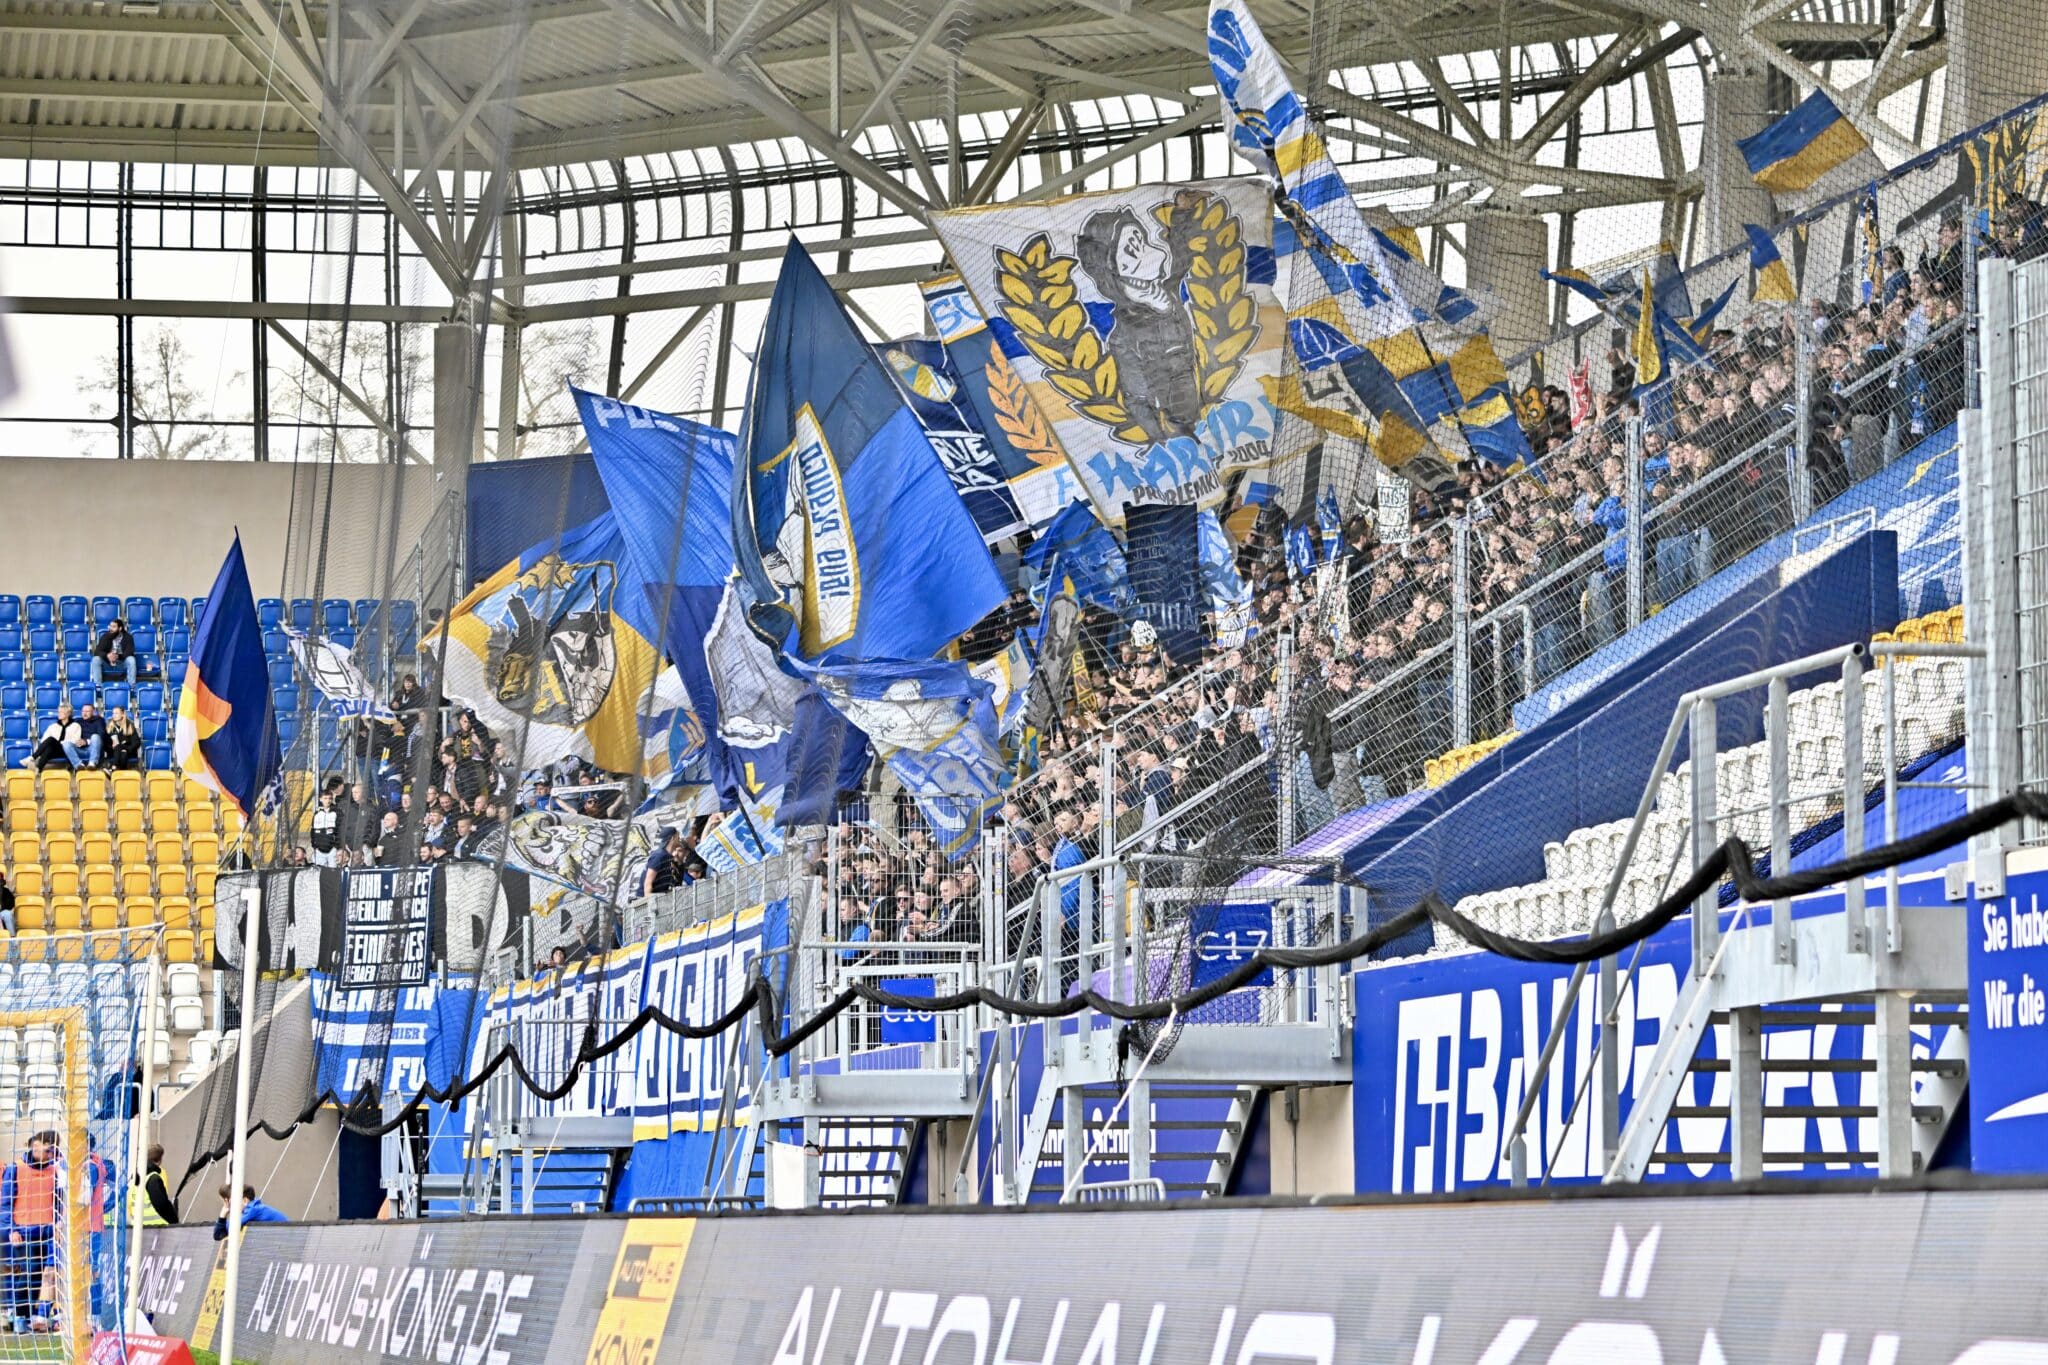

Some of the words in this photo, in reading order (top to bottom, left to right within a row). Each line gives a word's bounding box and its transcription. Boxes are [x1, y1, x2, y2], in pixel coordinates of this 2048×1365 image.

[1195, 930, 1268, 961] C17
[1982, 902, 2009, 953] Sie
[1983, 979, 2015, 1030] Wir
[2017, 973, 2046, 1028] die
